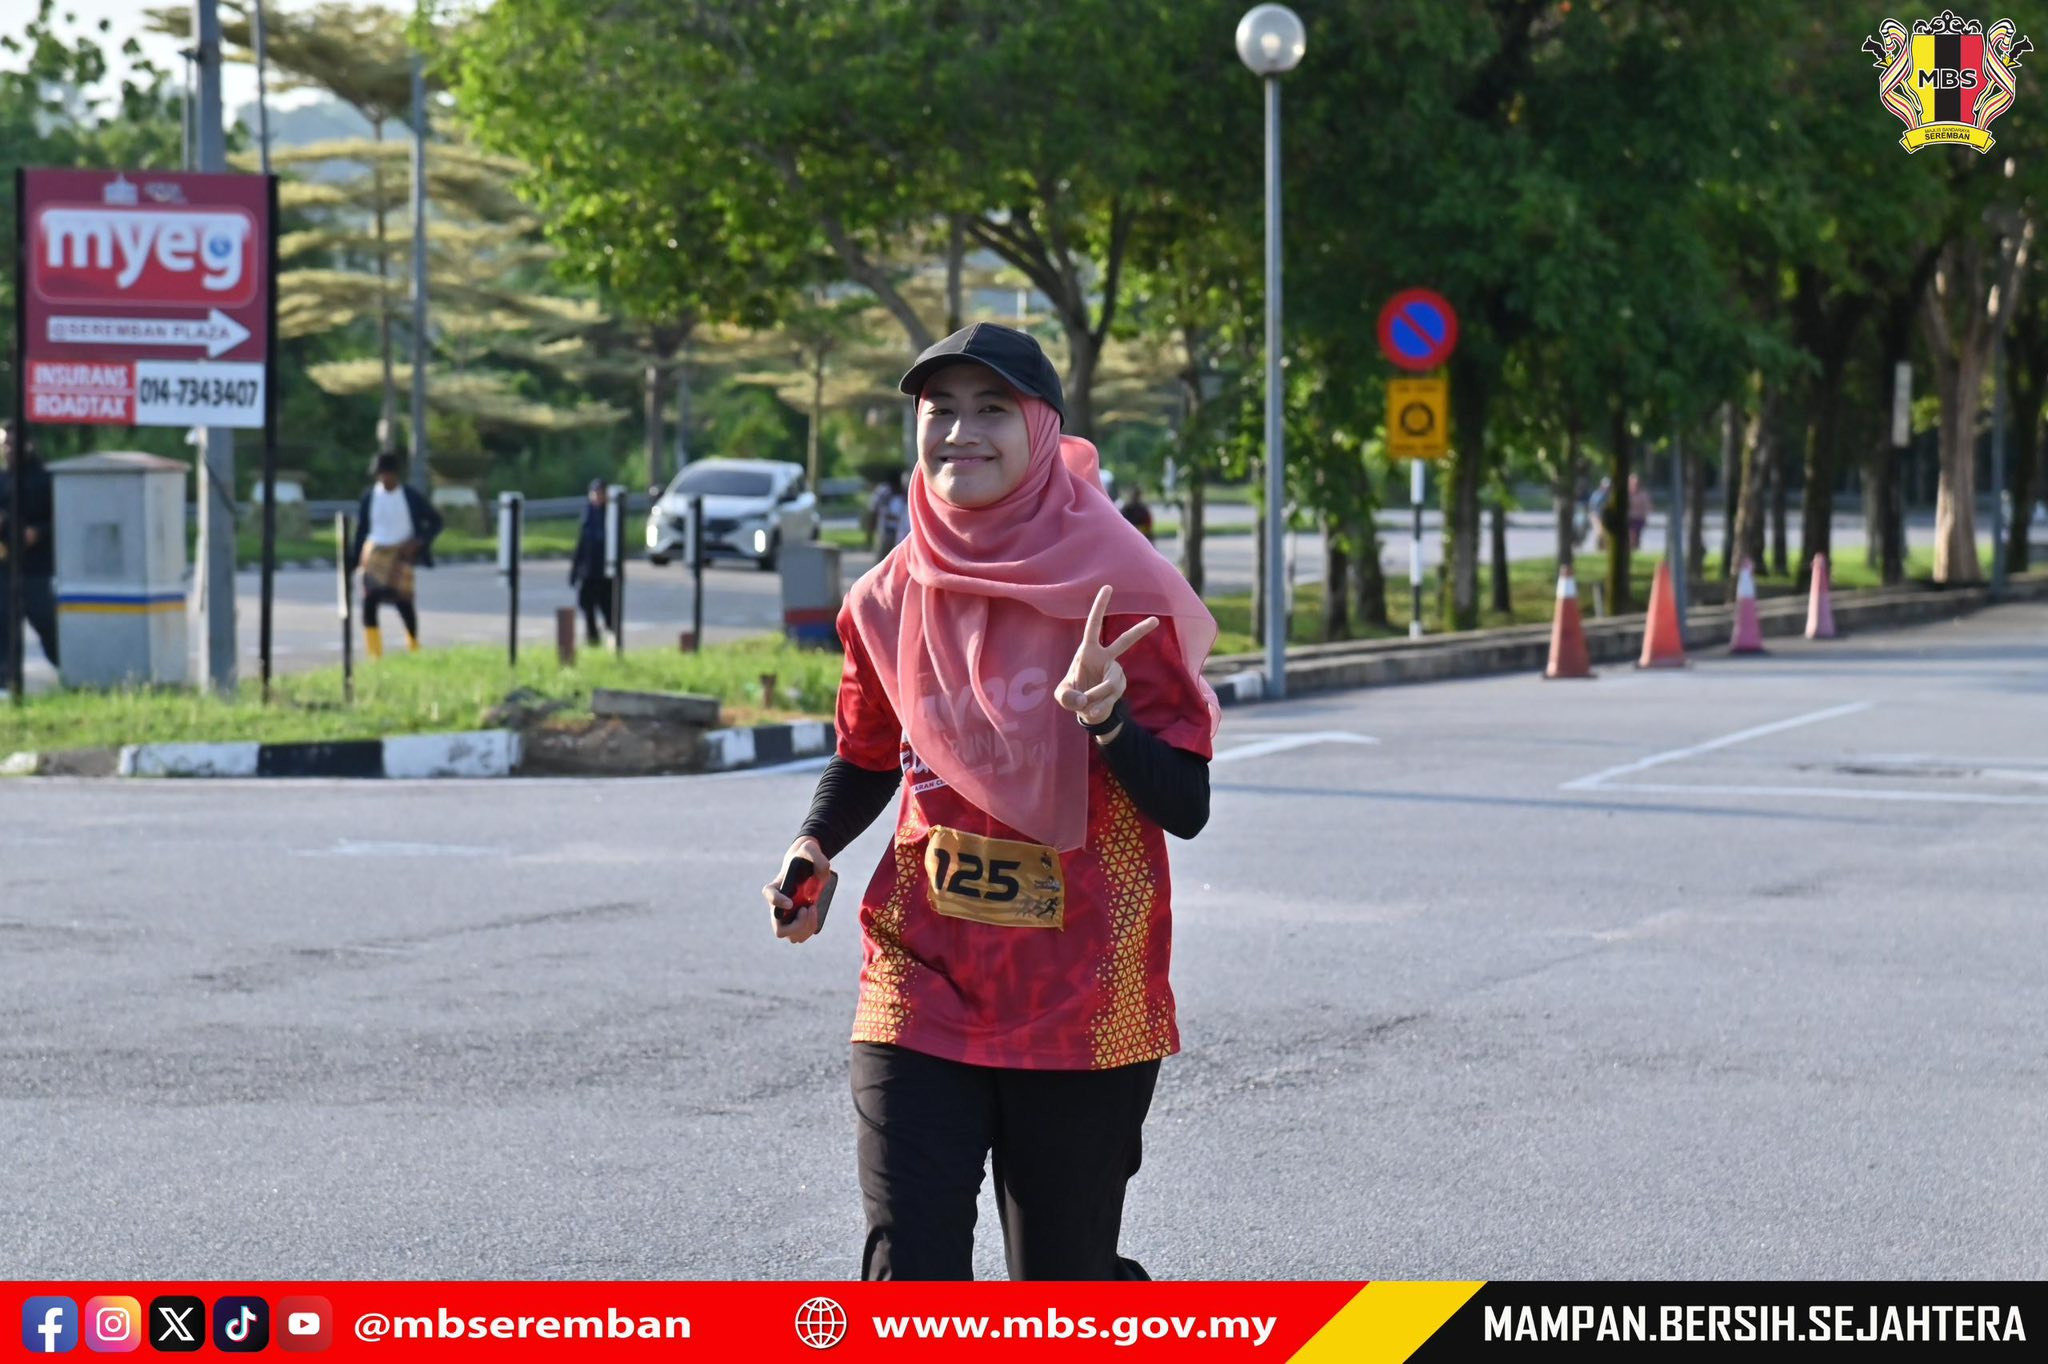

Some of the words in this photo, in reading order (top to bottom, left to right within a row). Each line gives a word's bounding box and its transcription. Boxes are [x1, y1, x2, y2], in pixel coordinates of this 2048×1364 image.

[41, 208, 250, 291] myeg
[174, 324, 231, 339] PLAZA
[33, 363, 128, 387] INSURANS
[140, 377, 258, 407] 014-7343407
[33, 394, 127, 418] ROADTAX
[934, 848, 1021, 901] 125
